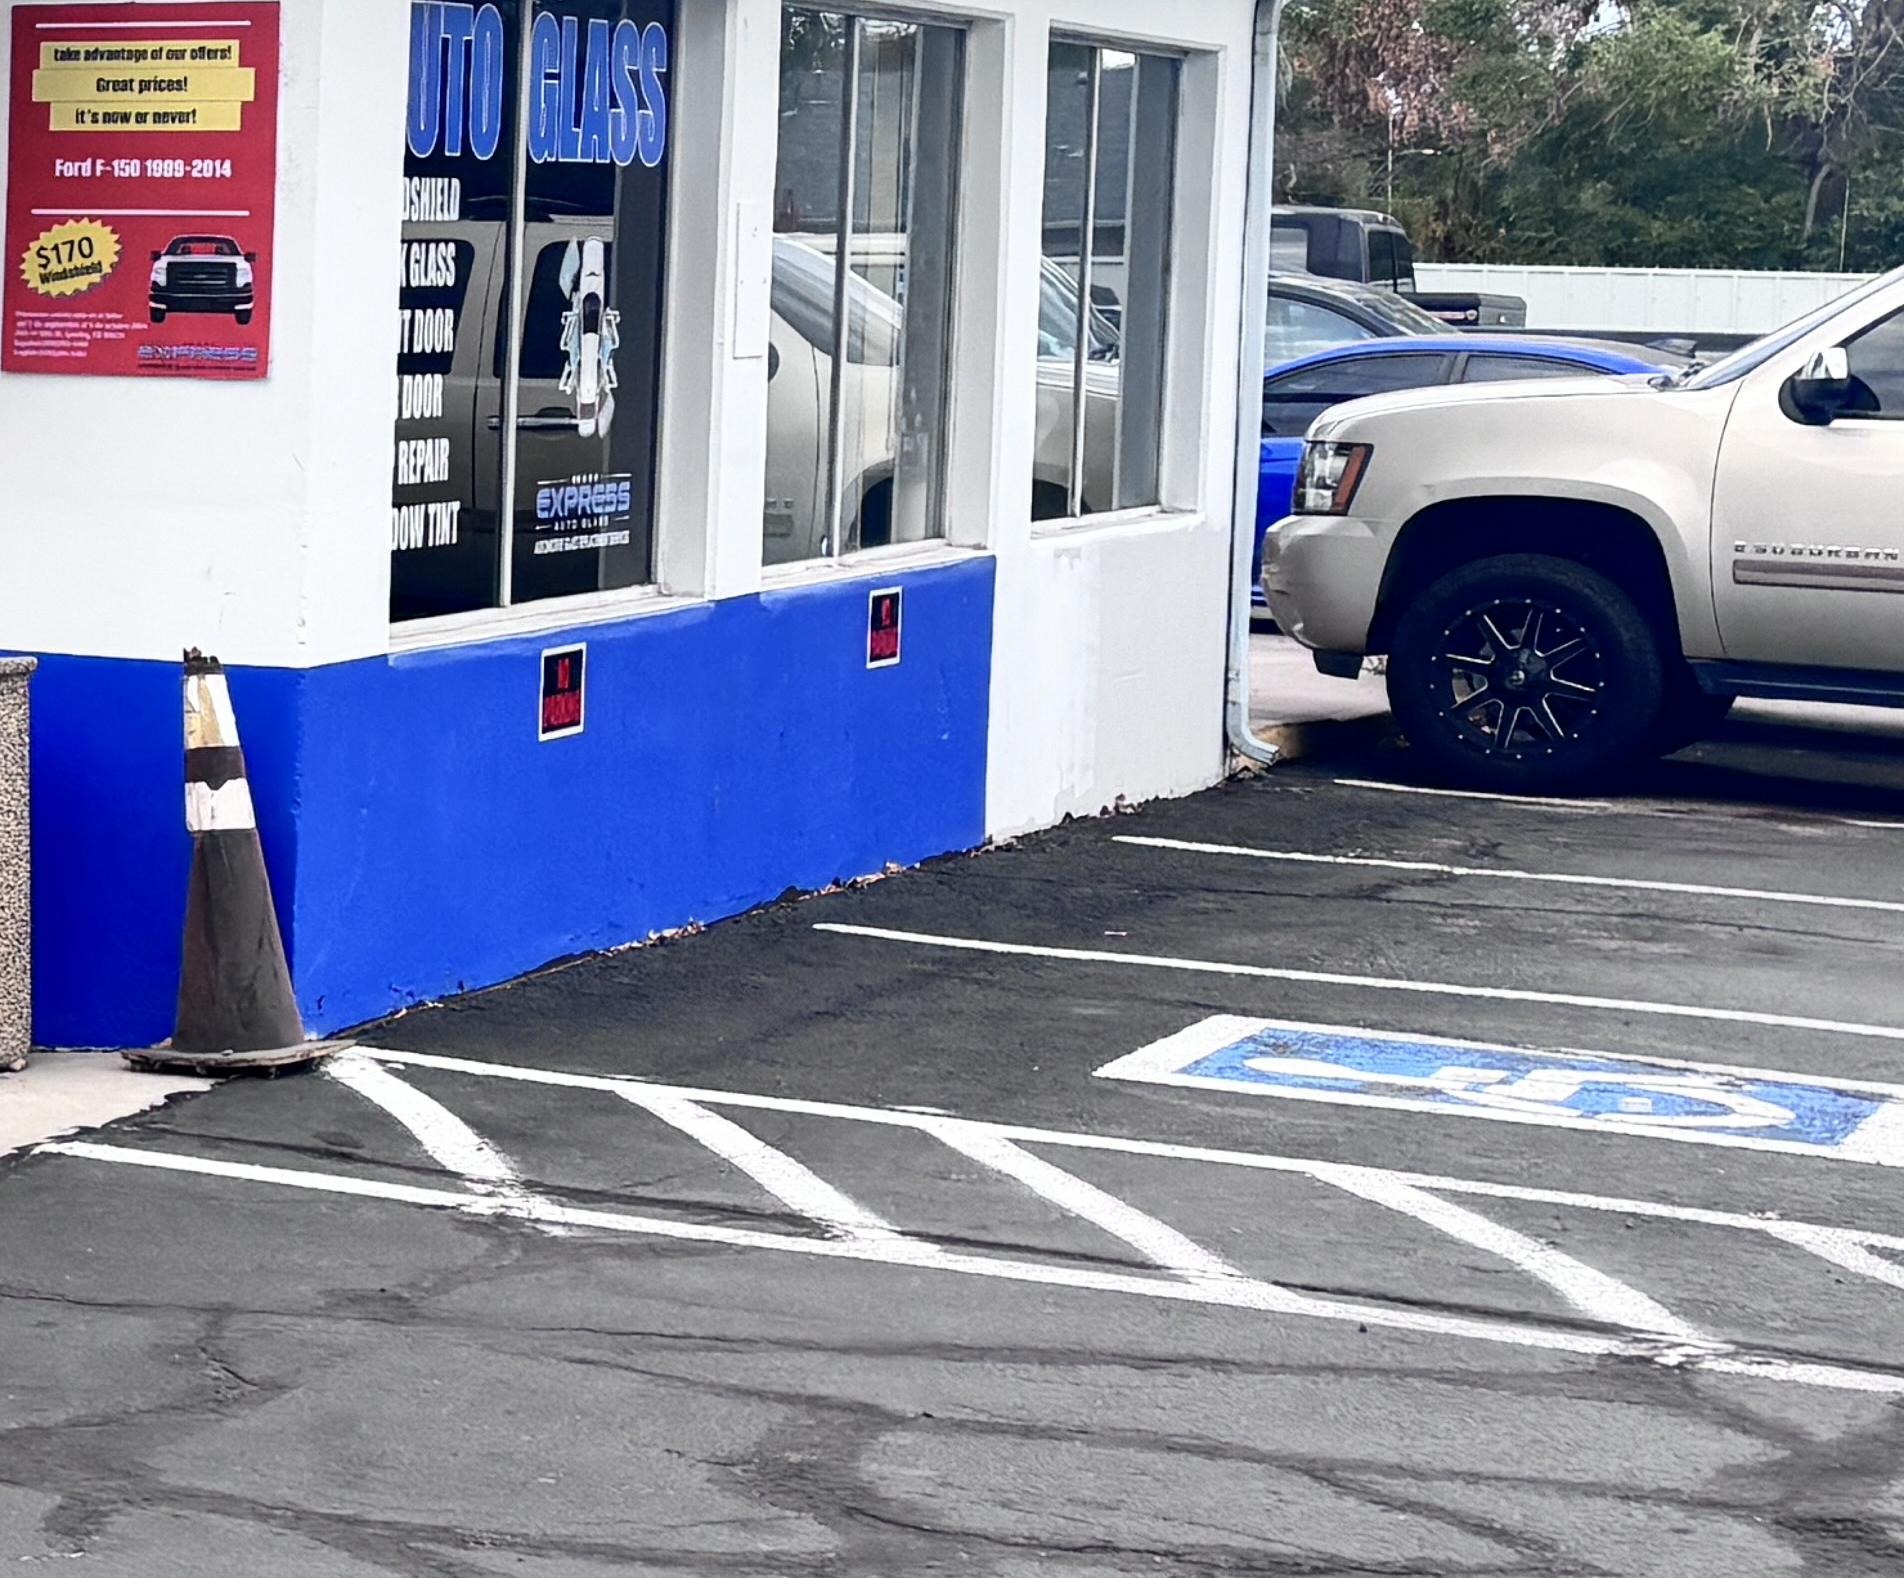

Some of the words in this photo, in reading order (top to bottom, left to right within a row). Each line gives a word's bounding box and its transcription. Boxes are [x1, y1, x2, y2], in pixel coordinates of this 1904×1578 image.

[150, 47, 163, 61] of
[96, 77, 135, 92] Great
[138, 76, 188, 94] prices!
[528, 10, 668, 168] GLASS
[102, 110, 132, 124] now
[135, 111, 150, 124] or
[54, 158, 92, 177] Ford
[96, 159, 141, 178] F-150
[36, 236, 94, 270] $170
[409, 241, 457, 288] GLASS
[413, 308, 454, 354] DOOR
[402, 373, 443, 419] DOOR
[397, 437, 450, 485] REPAIR
[536, 481, 631, 519] EXPRESS
[427, 500, 461, 547] TINT
